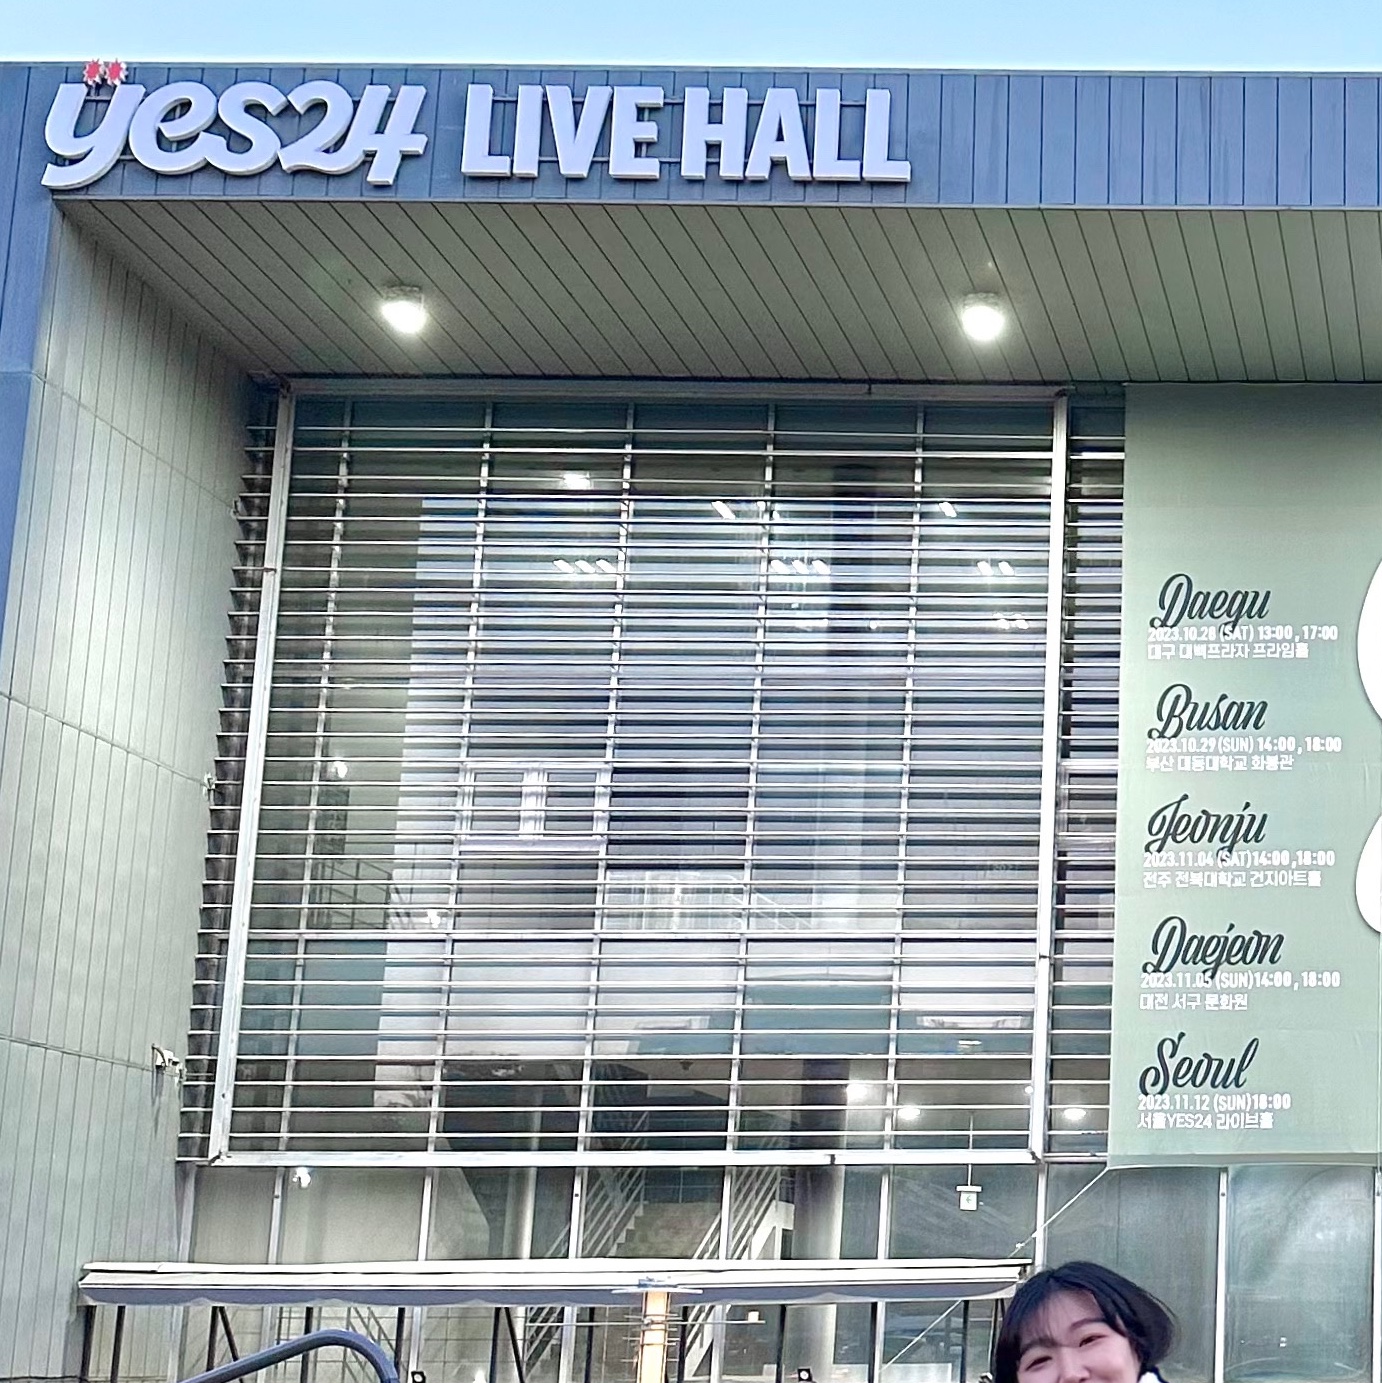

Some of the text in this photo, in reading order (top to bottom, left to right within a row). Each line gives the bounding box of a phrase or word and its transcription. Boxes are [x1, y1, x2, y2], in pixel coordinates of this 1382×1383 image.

[460, 83, 665, 181] LIVE
[681, 86, 911, 183] HALL
[1149, 573, 1271, 636] Daegu
[1147, 625, 1217, 642] 2023.10.28
[1302, 625, 1338, 640] 17:00
[1148, 643, 1176, 660] 대구
[1252, 642, 1309, 659] 프라임홀
[1147, 683, 1269, 739] Busan
[1305, 736, 1342, 752] 18:00
[1145, 756, 1175, 772] 부산
[1178, 756, 1248, 771] 대동대학교
[1144, 793, 1268, 862] Jeonju
[1143, 850, 1214, 868] 2023.11.04
[1143, 870, 1322, 889] 전주 전북대학교 건지아트홀
[1142, 916, 1284, 982] Daejeon
[1140, 971, 1213, 989] 2023.11.05
[1301, 971, 1340, 987] 18:00
[1139, 993, 1248, 1011] 대전 서구 문화원
[1139, 1032, 1260, 1095] Seoul
[1137, 1093, 1210, 1111] 2023.11.12
[1137, 1112, 1274, 1130] 서울YES24 라이브홀
